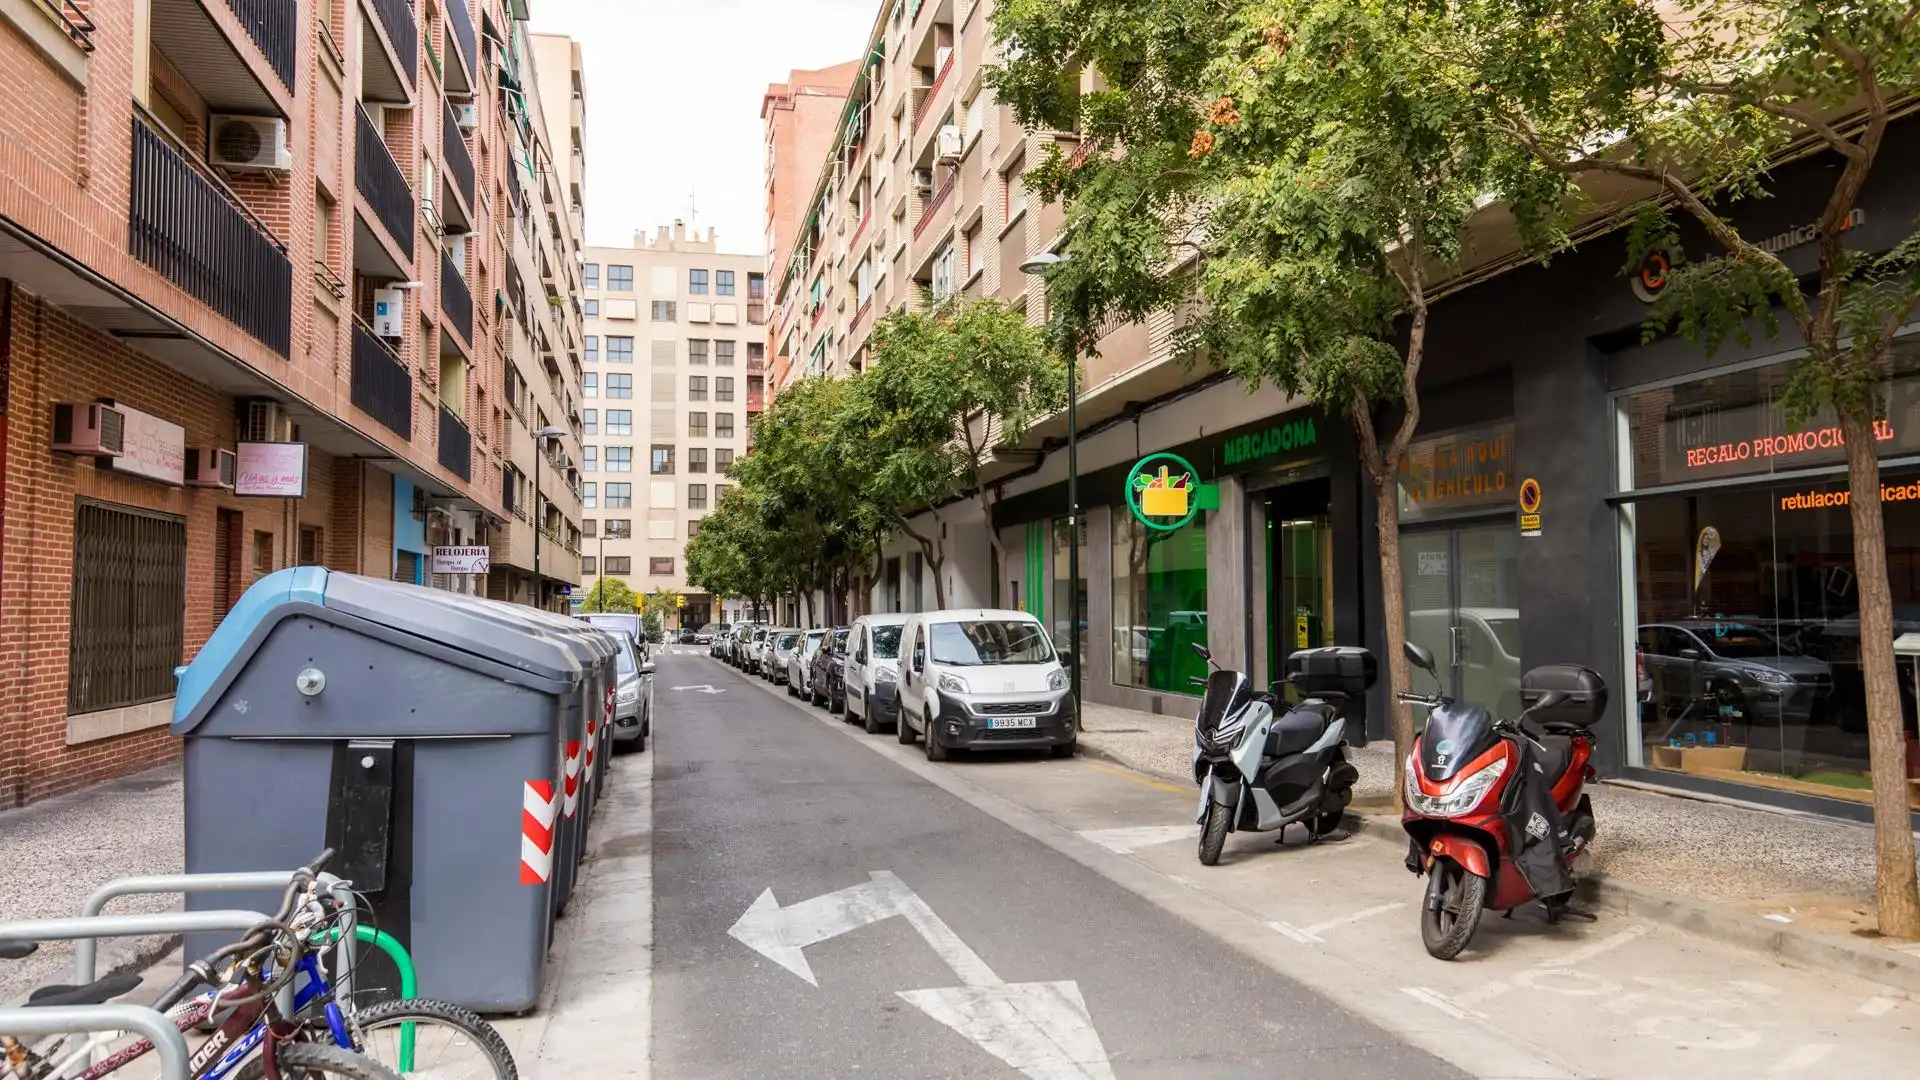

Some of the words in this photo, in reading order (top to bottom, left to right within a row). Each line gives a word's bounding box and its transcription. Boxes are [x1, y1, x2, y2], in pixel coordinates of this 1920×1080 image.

[1224, 417, 1316, 465] MERCADONA
[1687, 442, 1750, 466] REGALO
[1753, 420, 1894, 457] PROMOCIAL
[994, 719, 1016, 727] 9935
[1017, 718, 1034, 727] MCX
